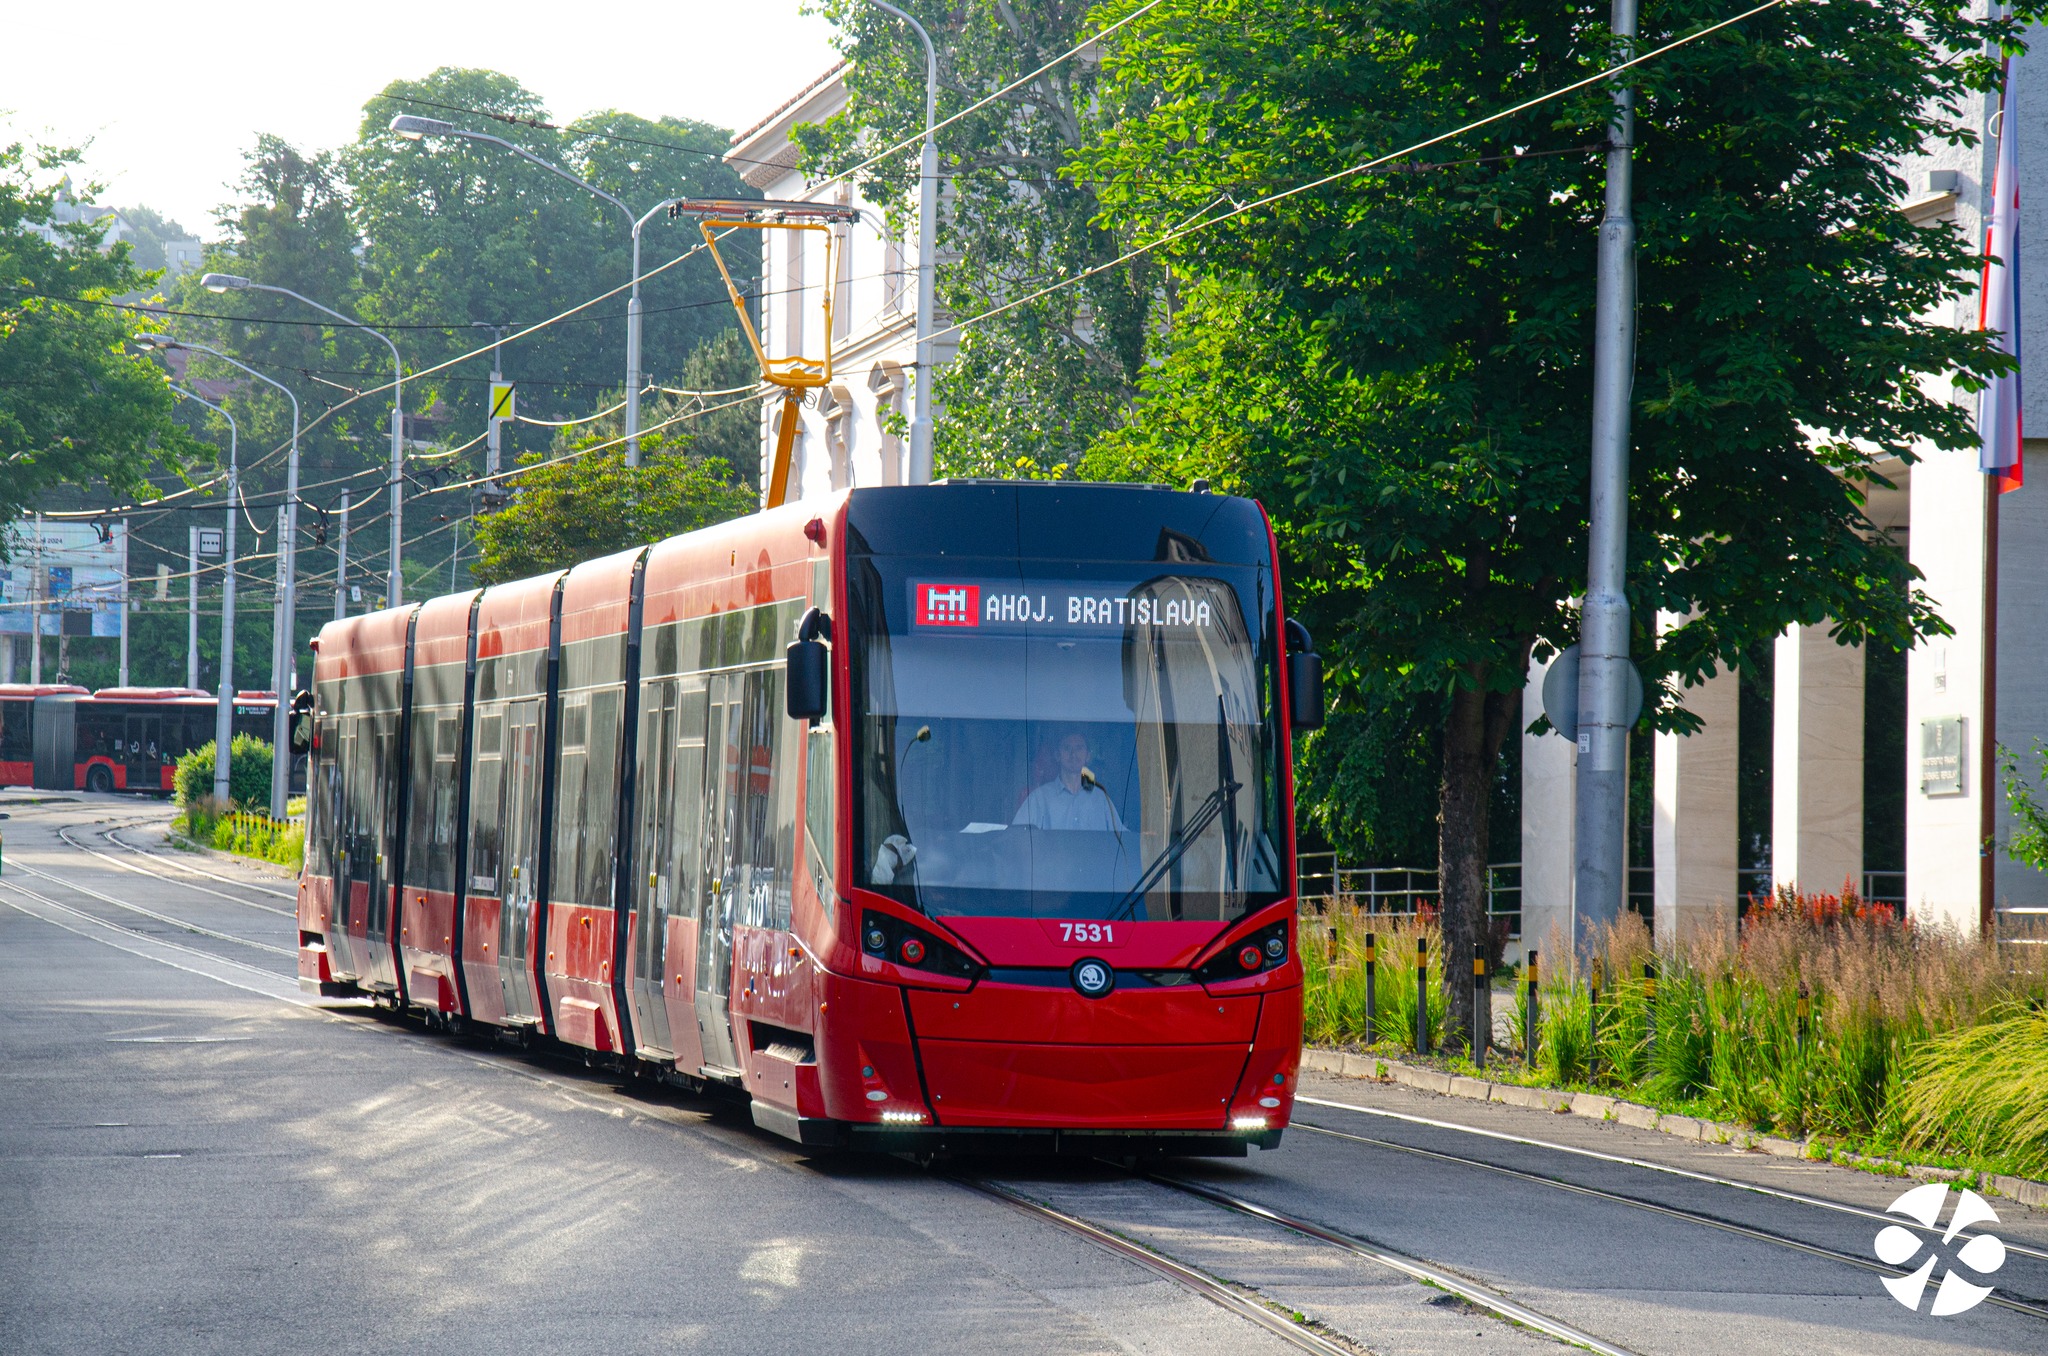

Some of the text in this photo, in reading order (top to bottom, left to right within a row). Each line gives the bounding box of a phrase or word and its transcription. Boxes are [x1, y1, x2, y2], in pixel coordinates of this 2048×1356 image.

[986, 594, 1210, 627] AHOJ, BRATISLAVA
[1059, 923, 1113, 943] 7531
